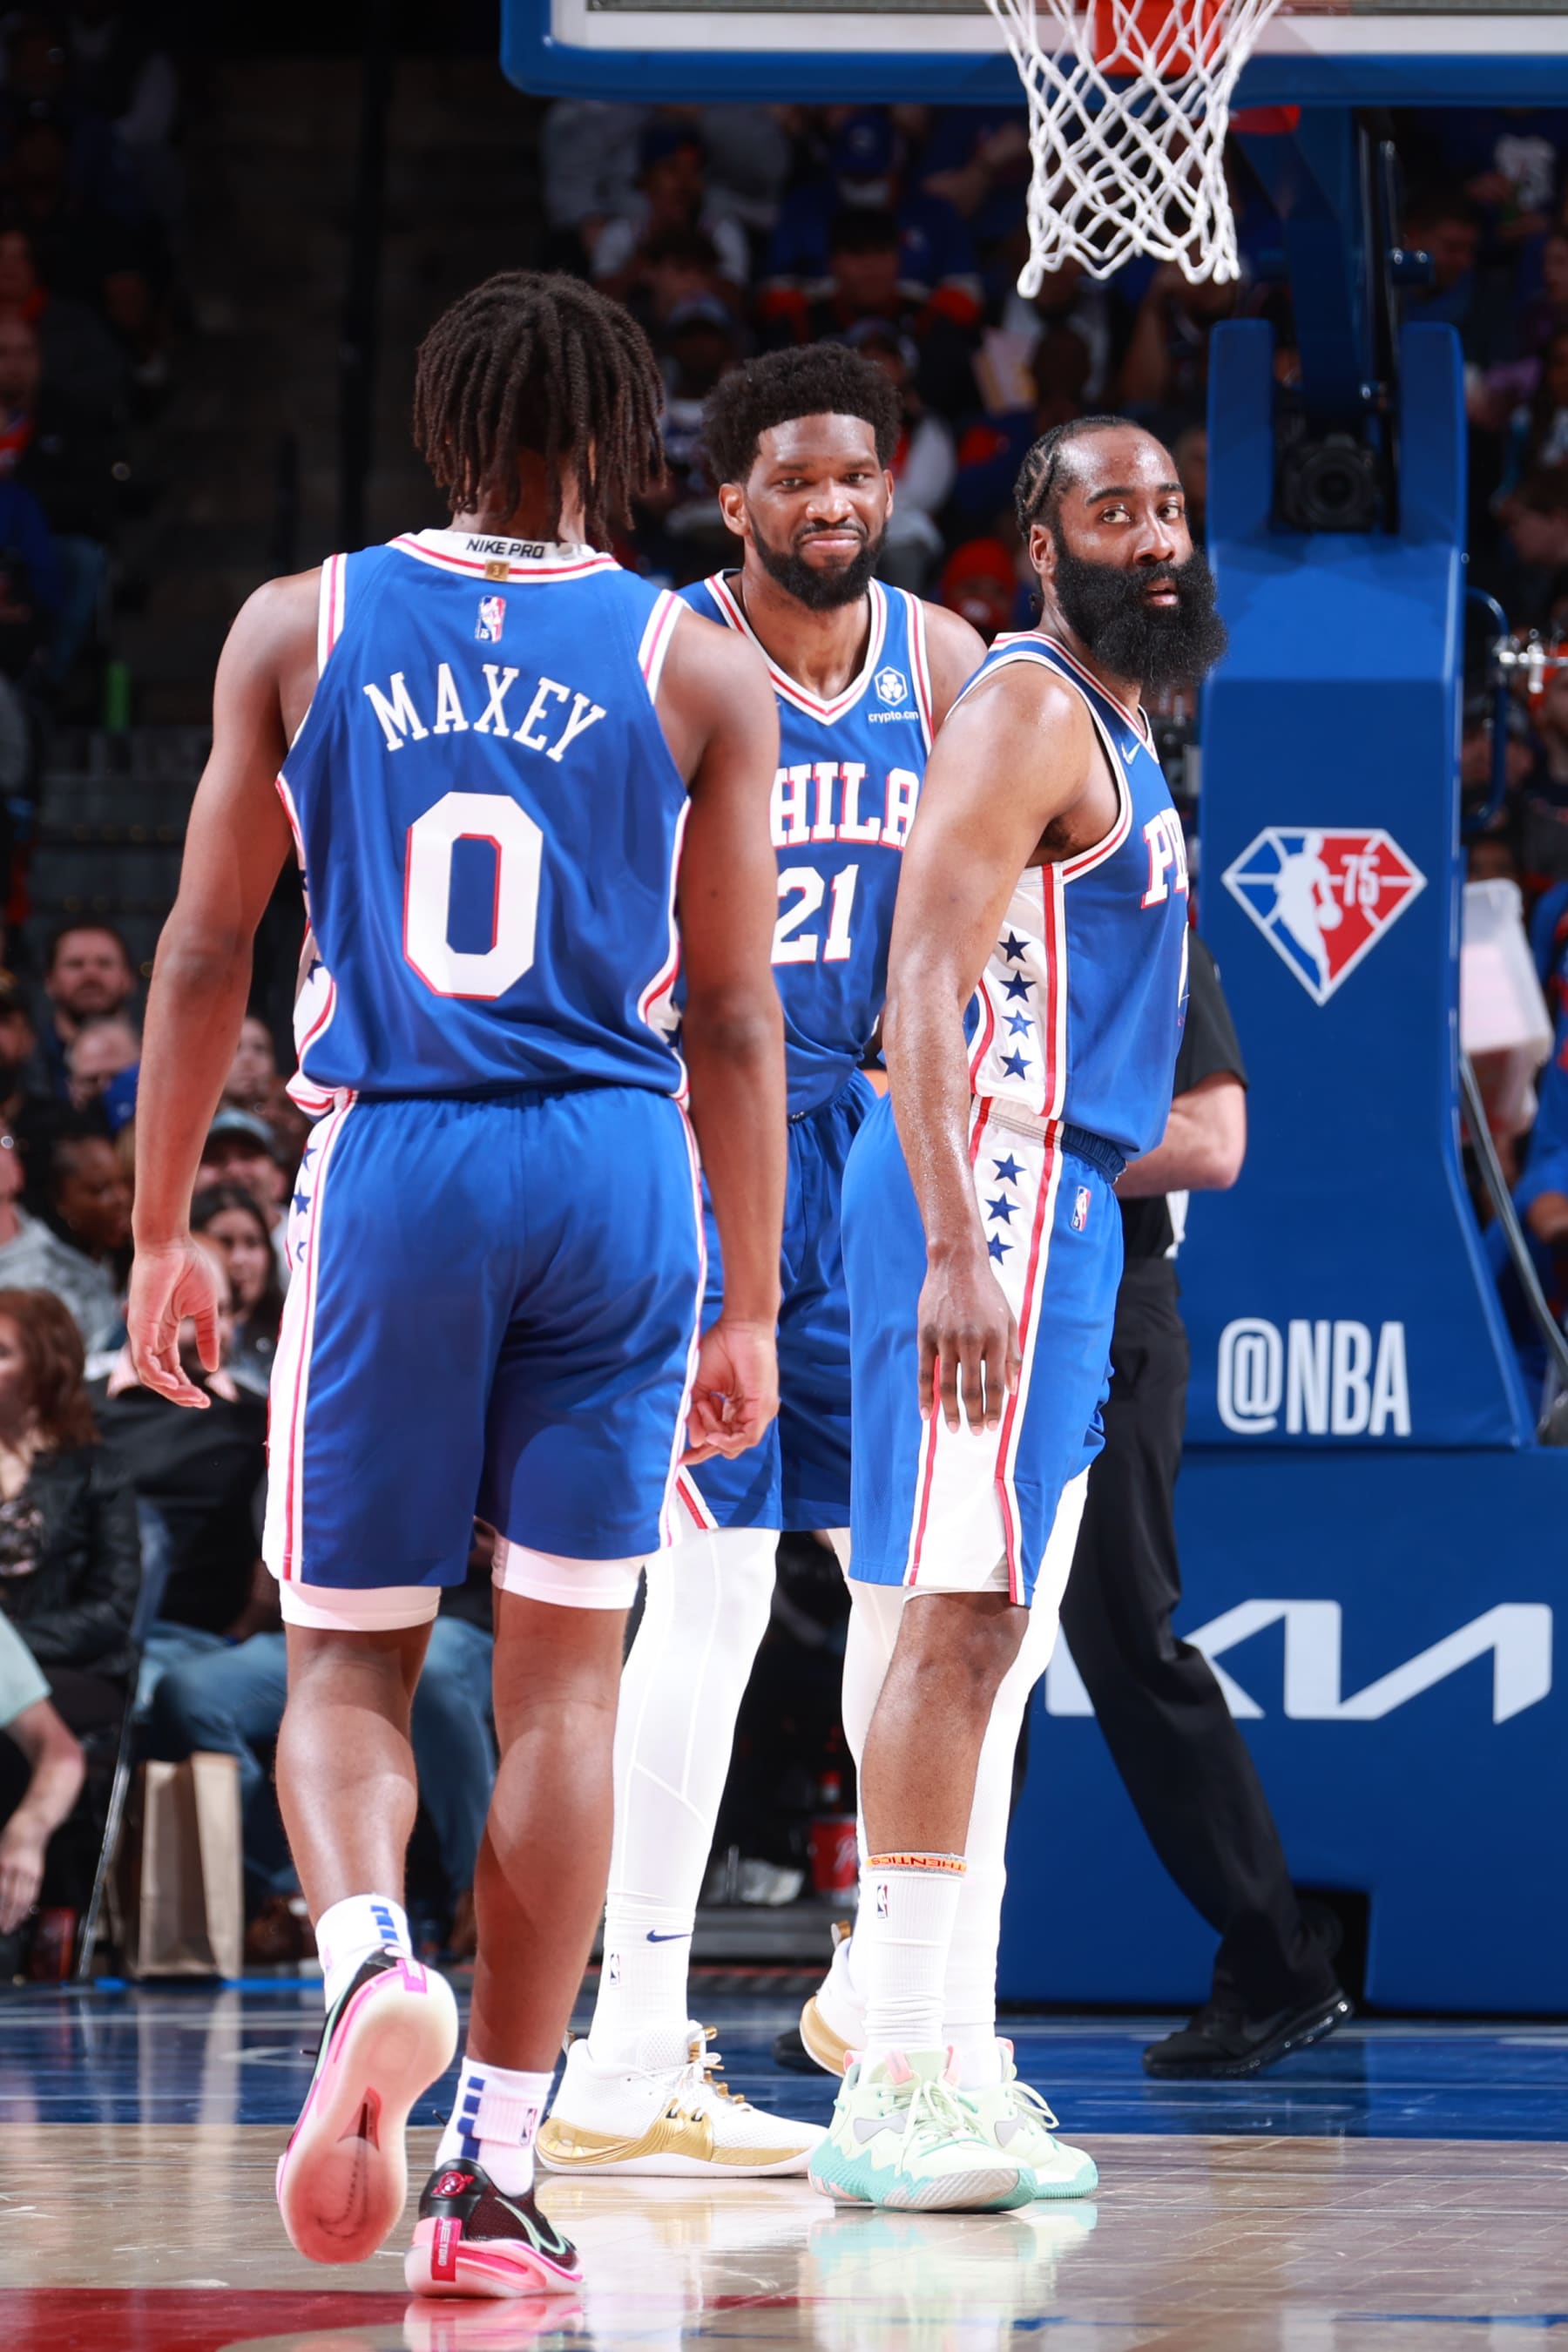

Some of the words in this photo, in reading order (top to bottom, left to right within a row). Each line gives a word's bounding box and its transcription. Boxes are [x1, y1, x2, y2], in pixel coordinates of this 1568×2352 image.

[466, 538, 507, 554] NIKE
[509, 543, 545, 559] PRO
[362, 663, 607, 763] MAXEY
[868, 711, 920, 724] crypto.cm
[403, 791, 544, 1002] 0
[770, 864, 859, 965] 21
[1341, 855, 1380, 907] 75
[1218, 1317, 1411, 1436] @NBA
